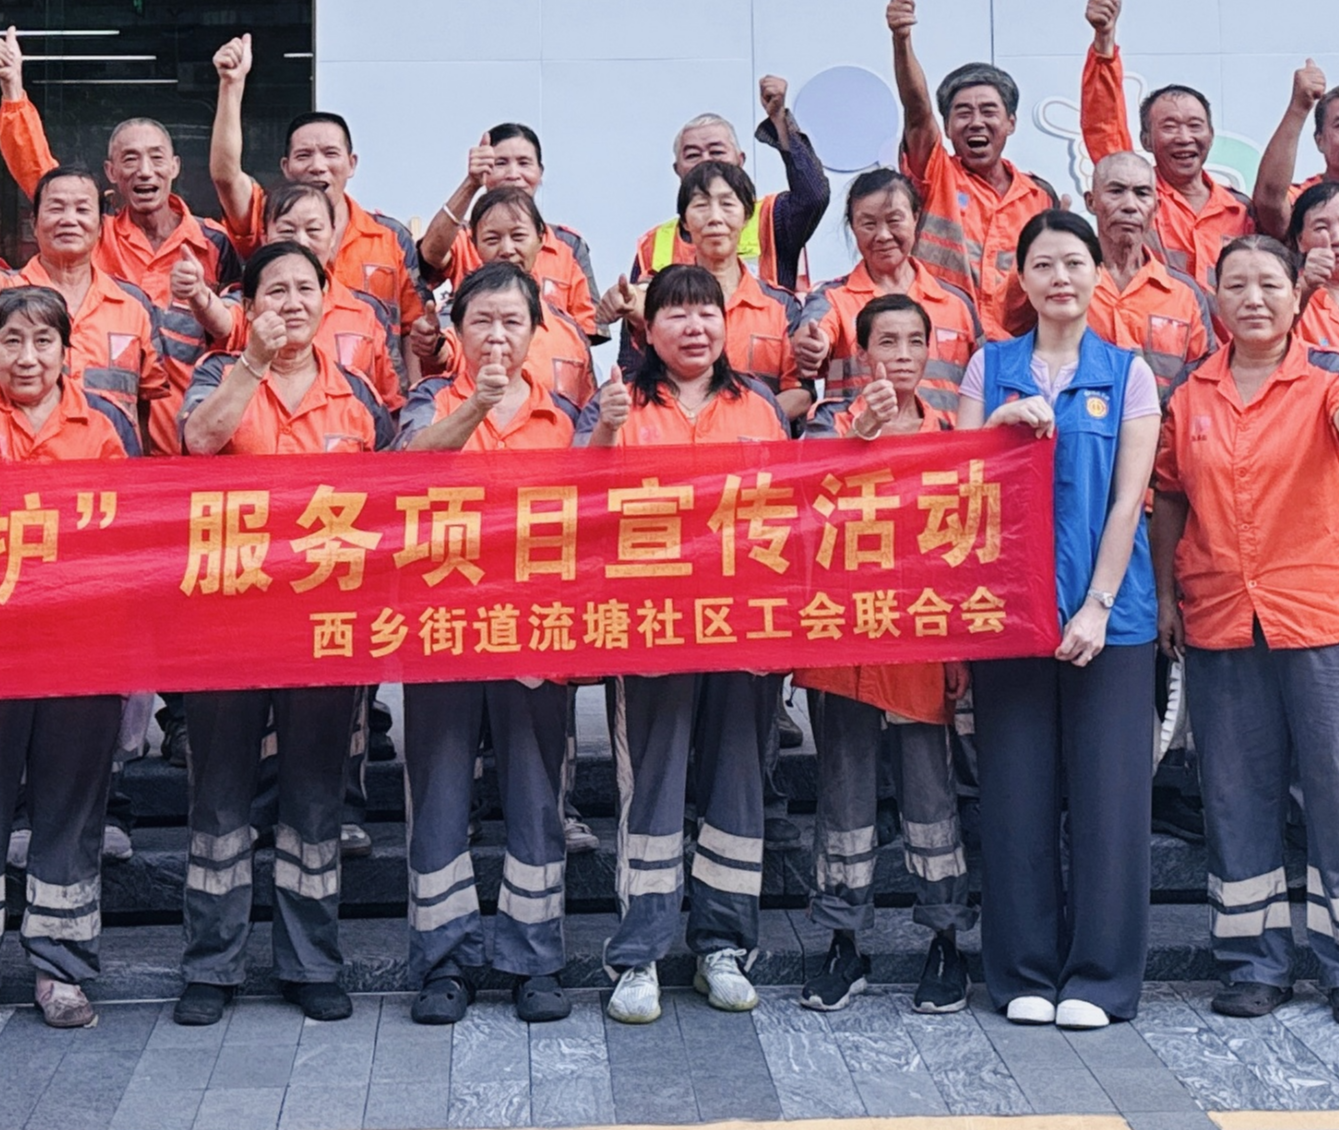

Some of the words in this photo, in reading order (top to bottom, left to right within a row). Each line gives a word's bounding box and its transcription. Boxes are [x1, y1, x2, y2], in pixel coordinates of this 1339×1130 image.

[178, 458, 1004, 598] 服务项目宣传活动
[310, 583, 1009, 659] 西乡街道流塘社区工会联合会
